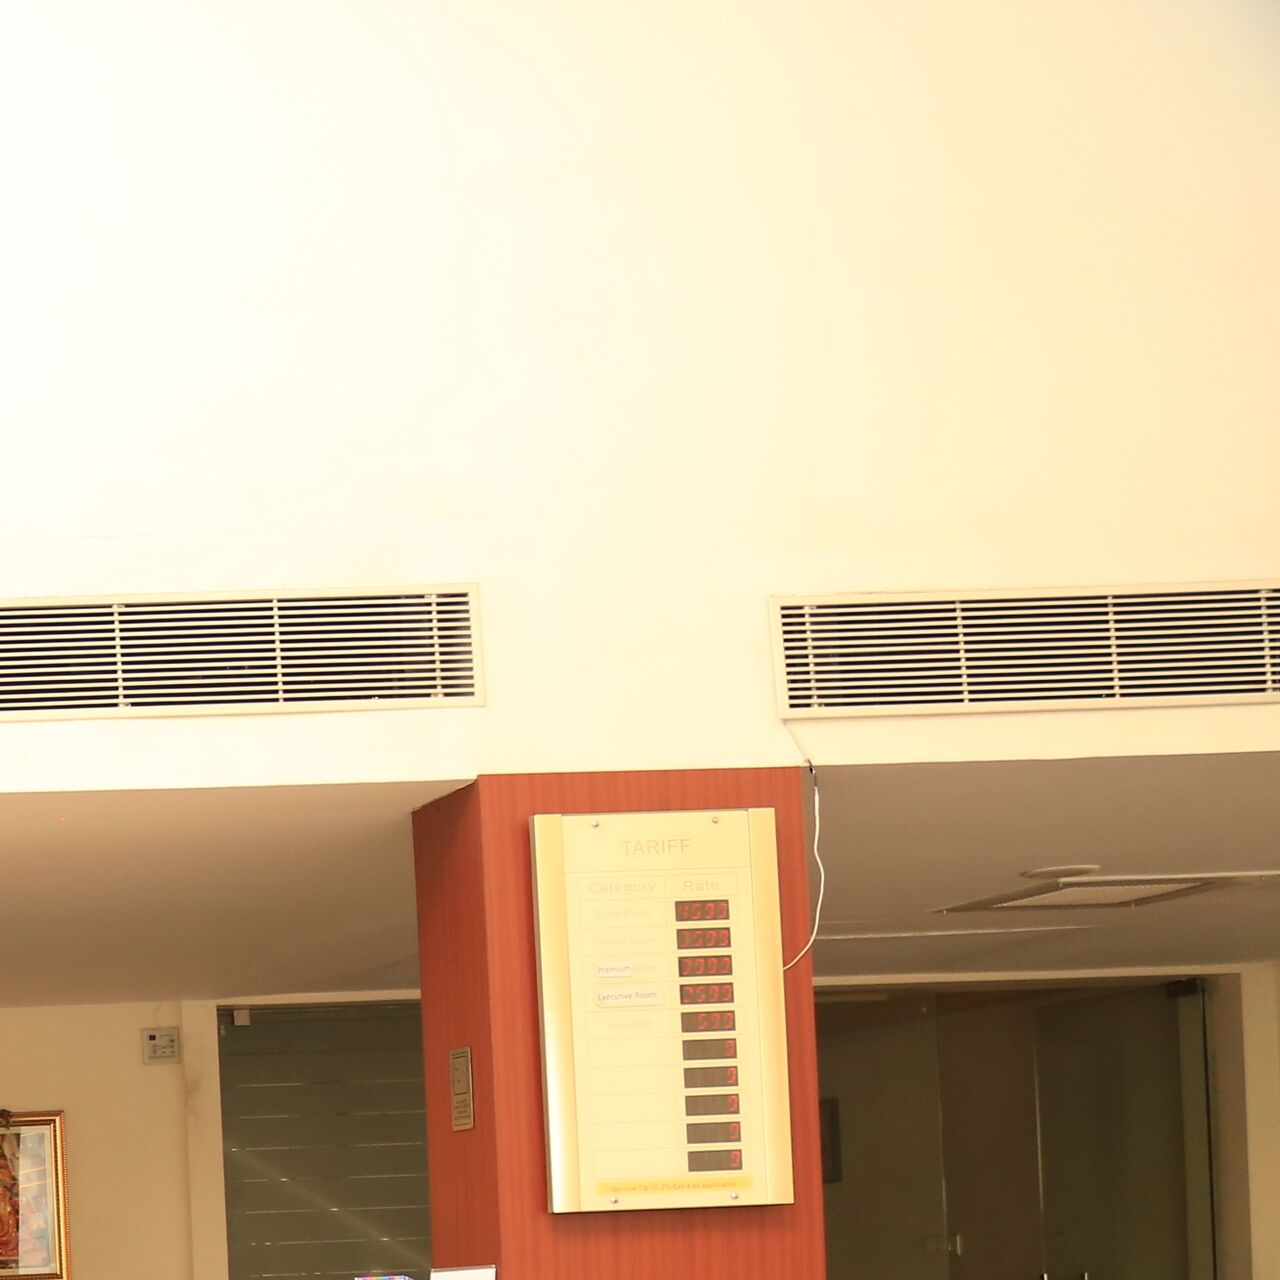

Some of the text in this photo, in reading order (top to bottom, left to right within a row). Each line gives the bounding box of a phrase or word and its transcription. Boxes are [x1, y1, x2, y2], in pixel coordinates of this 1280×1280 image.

[621, 838, 691, 856] TARIFF
[588, 880, 720, 895] Category Rate
[597, 965, 632, 974] Premium
[597, 991, 657, 1001] Executive Room
